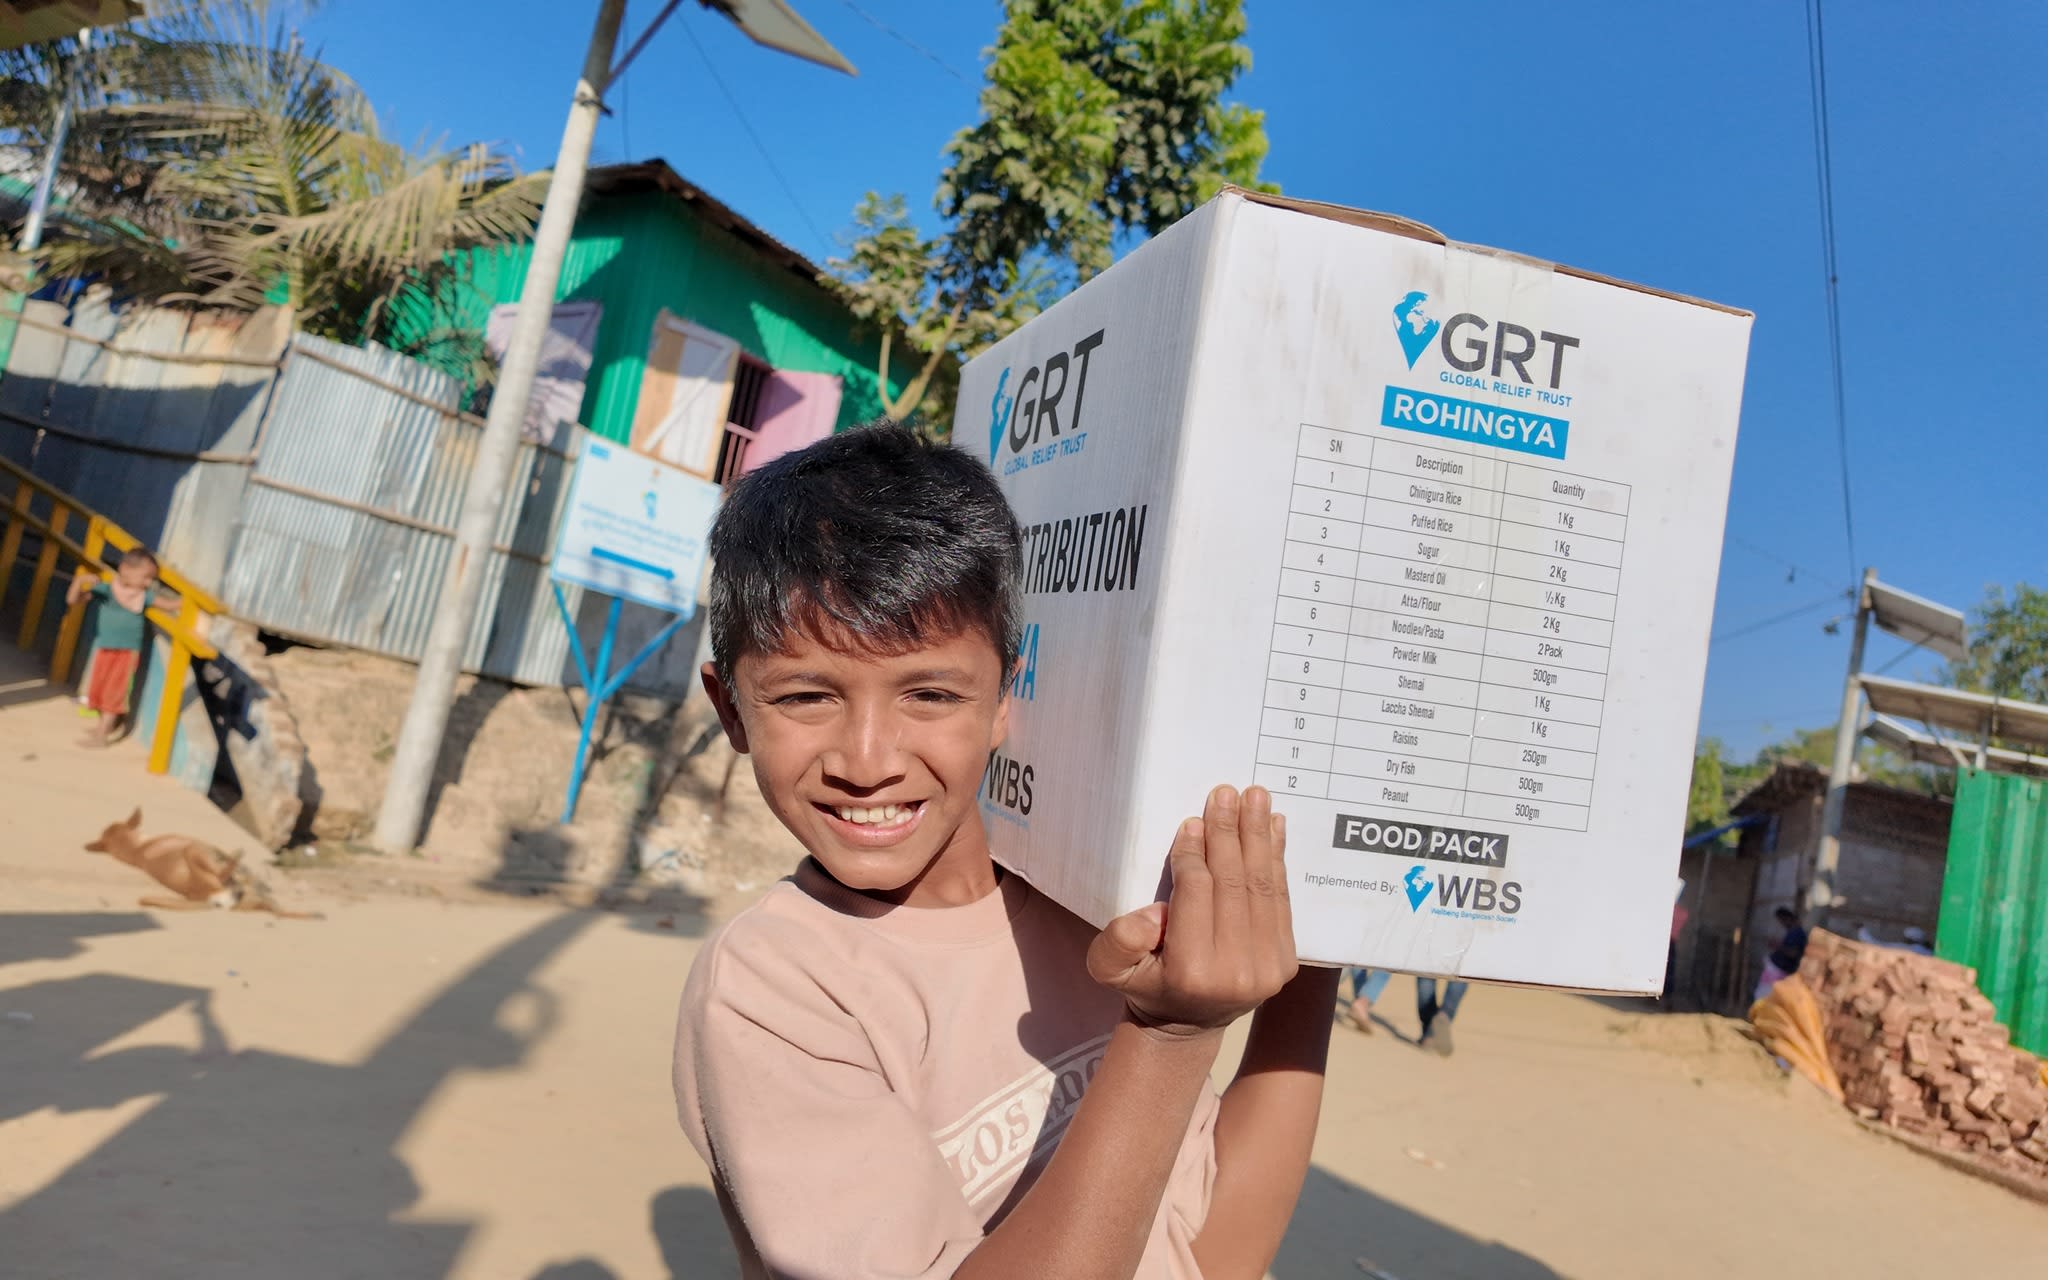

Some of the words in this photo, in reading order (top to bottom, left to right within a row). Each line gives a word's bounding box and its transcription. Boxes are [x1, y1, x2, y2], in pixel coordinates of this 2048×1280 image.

[1441, 312, 1580, 389] GRT
[1009, 328, 1105, 453] GRT
[1440, 371, 1488, 390] GLOBAL
[1493, 382, 1532, 399] RELIEF
[1536, 390, 1572, 407] TRUST
[1392, 393, 1556, 449] ROHINGYA
[1061, 432, 1087, 457] TRUST
[1329, 439, 1343, 453] SN
[1416, 454, 1463, 475] Description
[1410, 484, 1444, 504] Chinigura
[1446, 491, 1462, 506] Rice
[1552, 480, 1585, 500] Quantity
[1324, 499, 1332, 512] 2
[1321, 526, 1328, 539] 3
[1411, 514, 1436, 530] Puffed
[1437, 518, 1454, 533] Rice
[1022, 504, 1147, 594] TRIBUTION
[1317, 554, 1324, 566] 4
[1404, 568, 1436, 584] Masterd
[1436, 572, 1447, 586] Oil
[1314, 580, 1320, 593] 5
[1400, 594, 1442, 612] Atta/Flour
[1310, 608, 1317, 620] 6
[1392, 620, 1445, 640] Noodles/Pasta
[1307, 634, 1314, 647] 7
[1392, 646, 1420, 662] Powder
[1422, 650, 1438, 664] Milk
[1303, 661, 1310, 674] 8
[1398, 675, 1426, 691] Shemai
[1533, 669, 1558, 686] 500gm
[1300, 688, 1306, 701] 9
[1382, 700, 1406, 716] Laccha
[1408, 704, 1436, 719] Shemai
[1294, 718, 1305, 730] 10
[1392, 730, 1418, 746] Raisins
[1292, 747, 1299, 759] 11
[1522, 749, 1547, 766] 250gm
[1386, 759, 1400, 776] Dry
[1400, 761, 1416, 775] Fish
[987, 750, 1034, 815] WBS
[1288, 776, 1298, 788] 12
[1518, 777, 1544, 794] 500gm
[1382, 787, 1409, 803] Peanut
[1515, 803, 1540, 821] 500gm
[1344, 820, 1422, 850] FOOD
[1430, 831, 1500, 860] PACK
[1304, 872, 1378, 891] Implemented
[1380, 881, 1399, 896] By:
[1437, 873, 1523, 914] WBS
